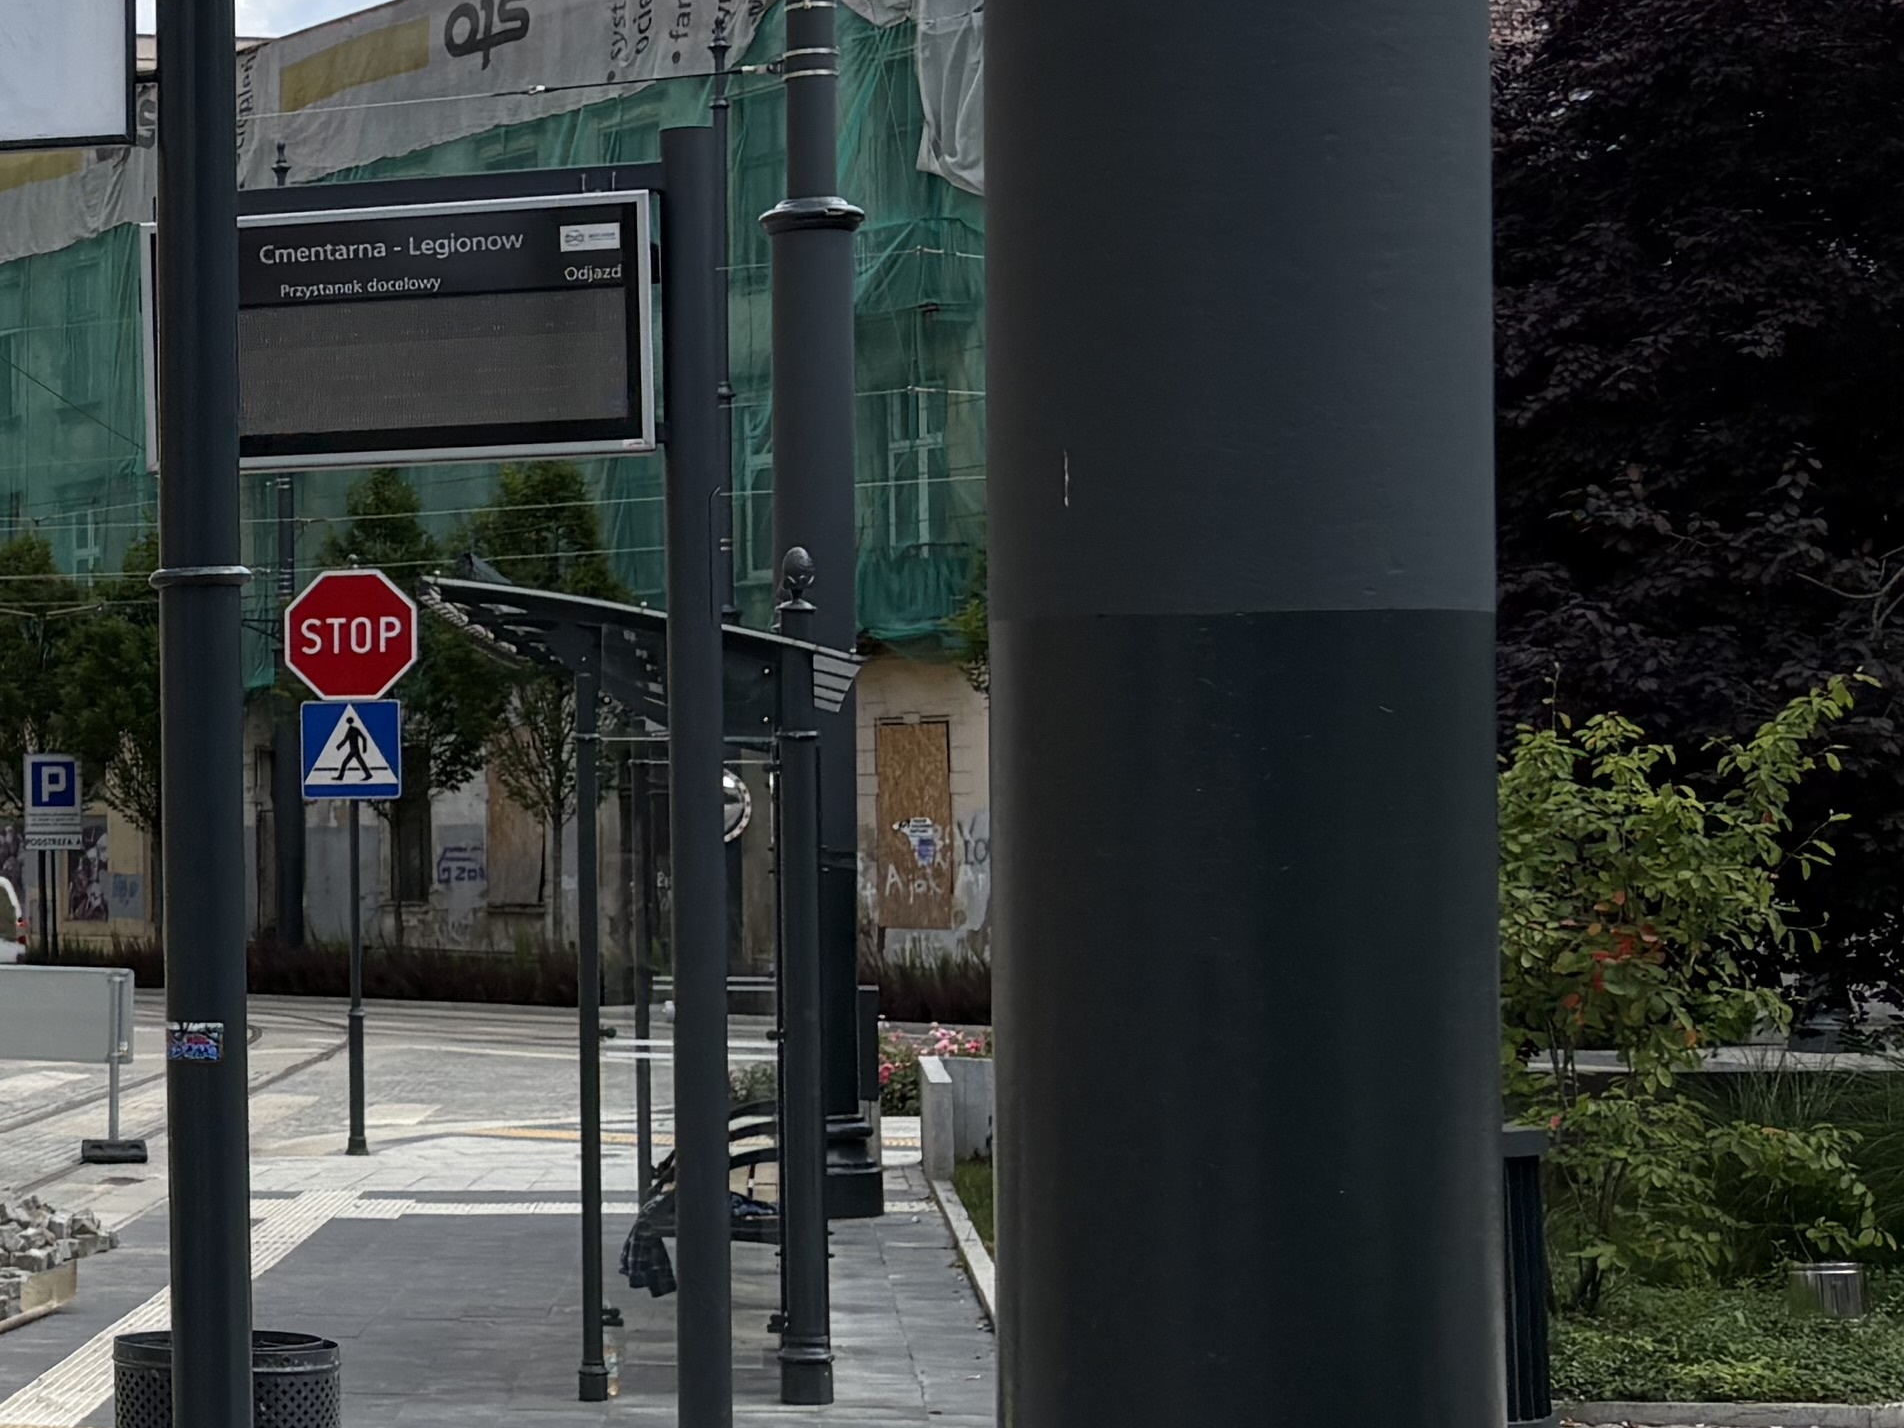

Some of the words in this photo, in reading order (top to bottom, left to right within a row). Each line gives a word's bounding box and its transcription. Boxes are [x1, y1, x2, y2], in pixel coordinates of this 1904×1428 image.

[259, 243, 386, 265] Cmentarna
[408, 232, 524, 259] Legionow
[280, 280, 363, 299] Przystanek
[367, 276, 441, 293] docelowy
[564, 264, 622, 283] Odjazd
[301, 616, 402, 654] STOP
[41, 765, 67, 803] P
